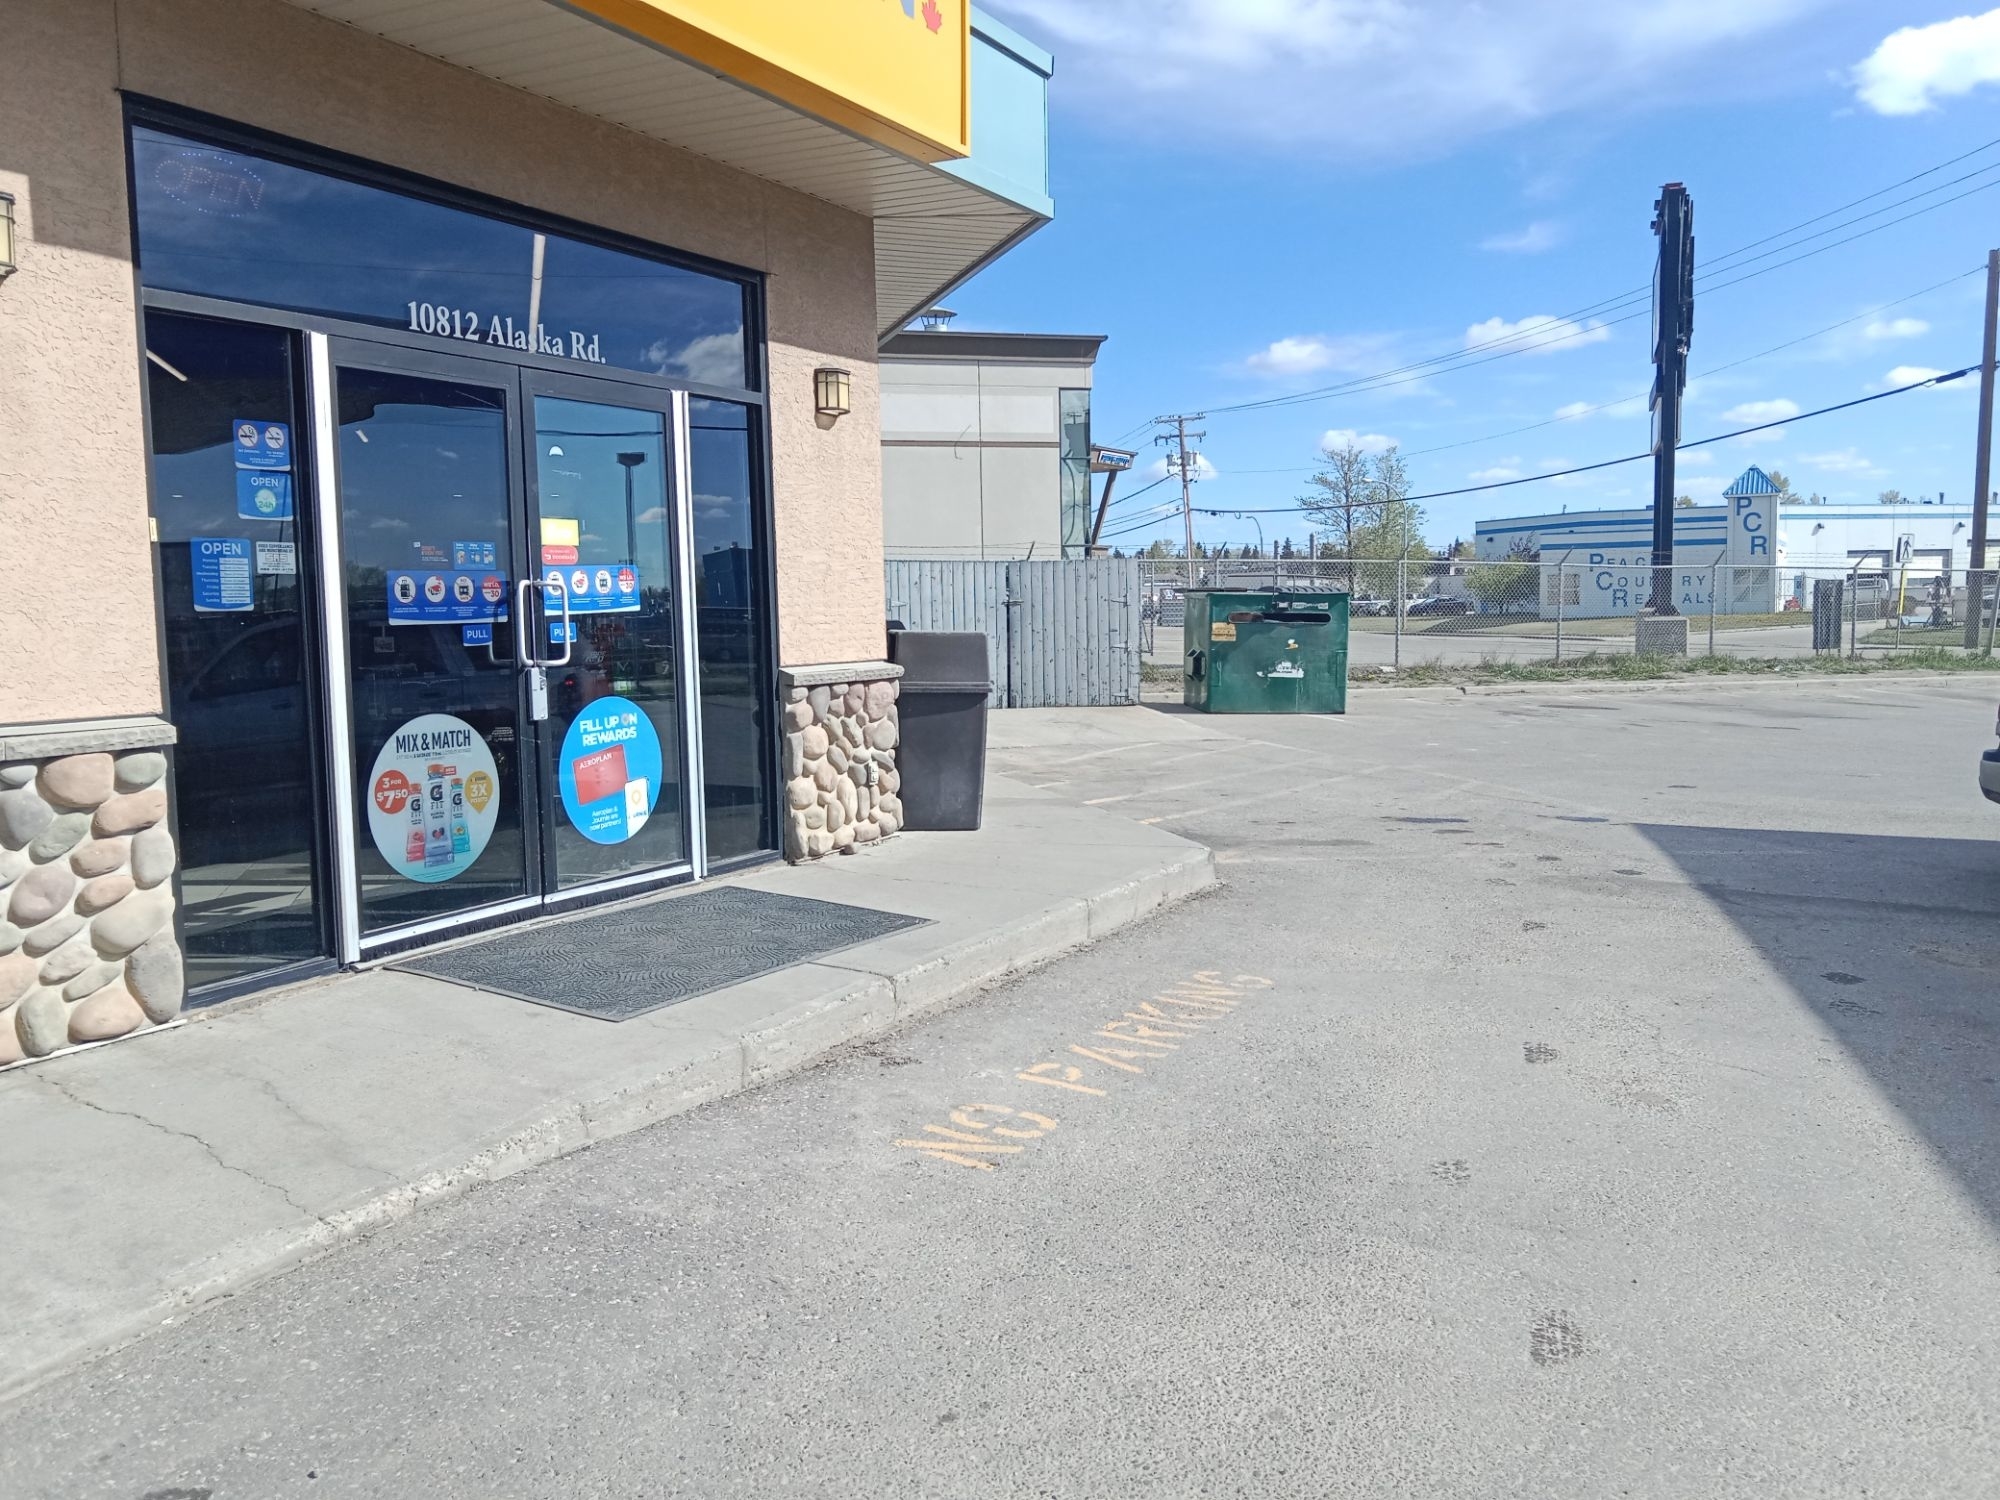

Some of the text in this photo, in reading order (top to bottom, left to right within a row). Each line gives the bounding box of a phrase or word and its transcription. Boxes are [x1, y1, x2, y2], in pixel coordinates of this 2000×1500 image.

[155, 160, 265, 209] OPEN
[408, 301, 606, 364] 10812 Alaska Rd.
[251, 477, 279, 487] OPEN
[201, 542, 242, 555] OPEN
[1590, 553, 1655, 571] PEAC
[1596, 571, 1705, 590] COURY
[1612, 589, 1714, 607] REALS
[467, 629, 488, 639] PULL
[580, 713, 638, 733] FILL UP ON
[395, 734, 419, 754] MIX
[421, 733, 430, 750] &
[431, 729, 471, 750] MATCH
[582, 727, 638, 747] REWARDS
[580, 753, 612, 769] AEROPLAN
[382, 777, 390, 788] 3
[470, 783, 487, 797] 3X
[894, 970, 1275, 1171] NO PARKING
